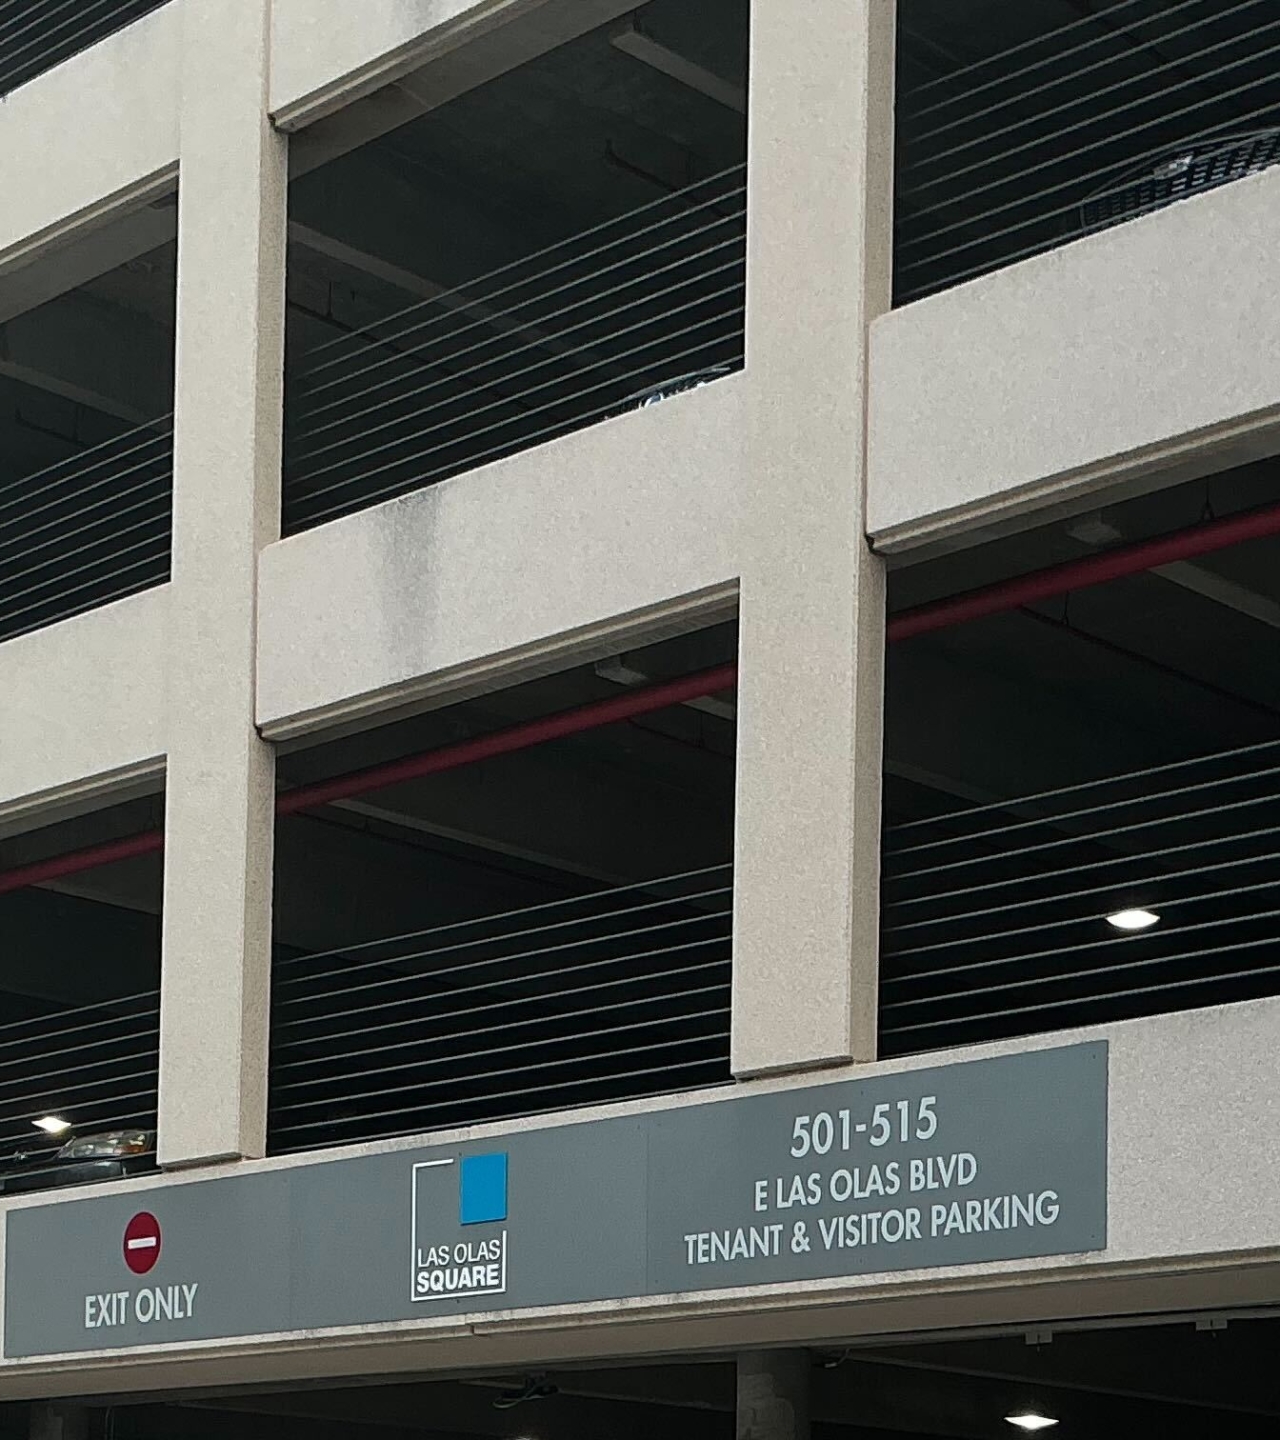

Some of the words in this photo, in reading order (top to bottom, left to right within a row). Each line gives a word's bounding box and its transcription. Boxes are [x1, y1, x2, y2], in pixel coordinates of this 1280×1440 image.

[790, 1095, 938, 1158] 501-515
[754, 1180, 768, 1212] E
[776, 1172, 822, 1208] LAS
[829, 1162, 900, 1202] OLAS
[909, 1152, 978, 1193] BLVD
[416, 1242, 450, 1268] LAS
[453, 1238, 502, 1266] OLAS
[684, 1224, 784, 1265] TENANT
[790, 1220, 812, 1254] &
[818, 1207, 921, 1251] VISITOR
[930, 1189, 1060, 1238] PARKING
[416, 1263, 500, 1294] SQUARE
[84, 1289, 132, 1329] EXIT
[134, 1283, 199, 1326] ONLY
